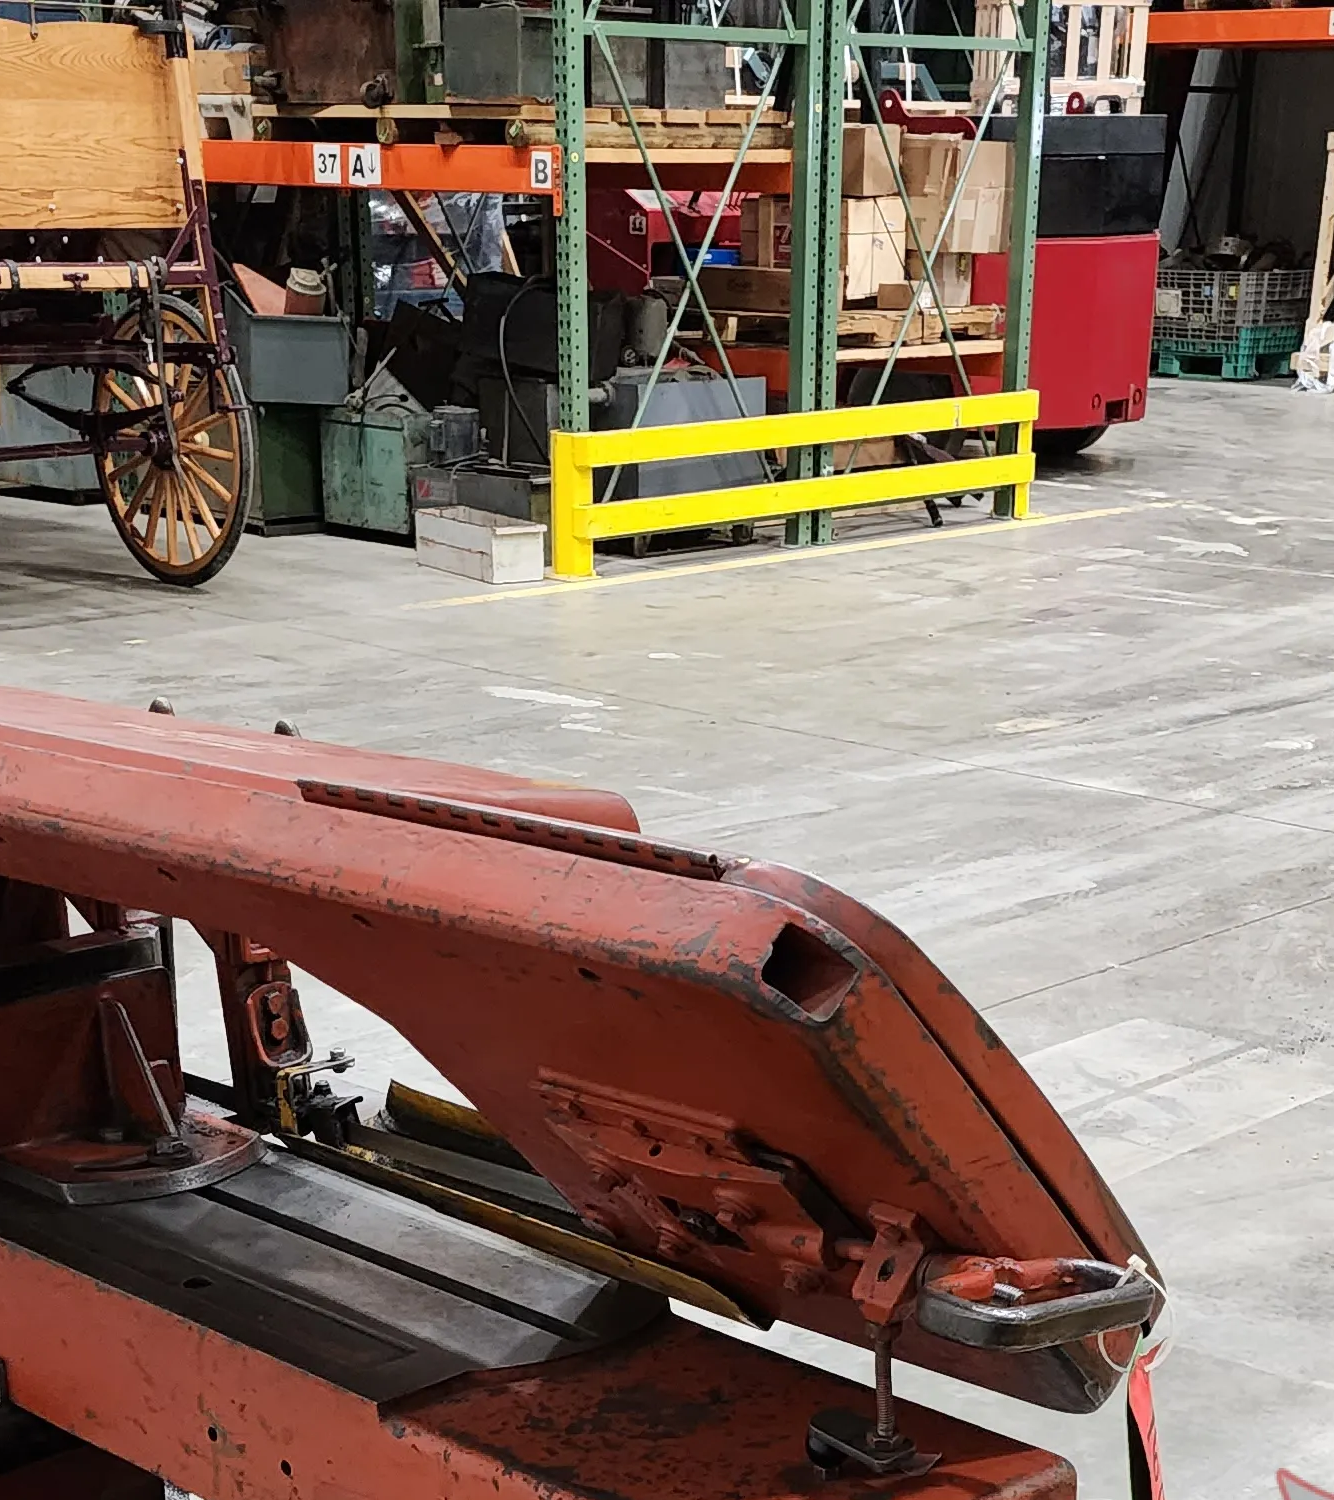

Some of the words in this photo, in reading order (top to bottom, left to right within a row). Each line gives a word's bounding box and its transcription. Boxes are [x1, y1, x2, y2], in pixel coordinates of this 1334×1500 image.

[318, 153, 337, 174] 37
[351, 154, 366, 178] A
[534, 158, 549, 184] B
